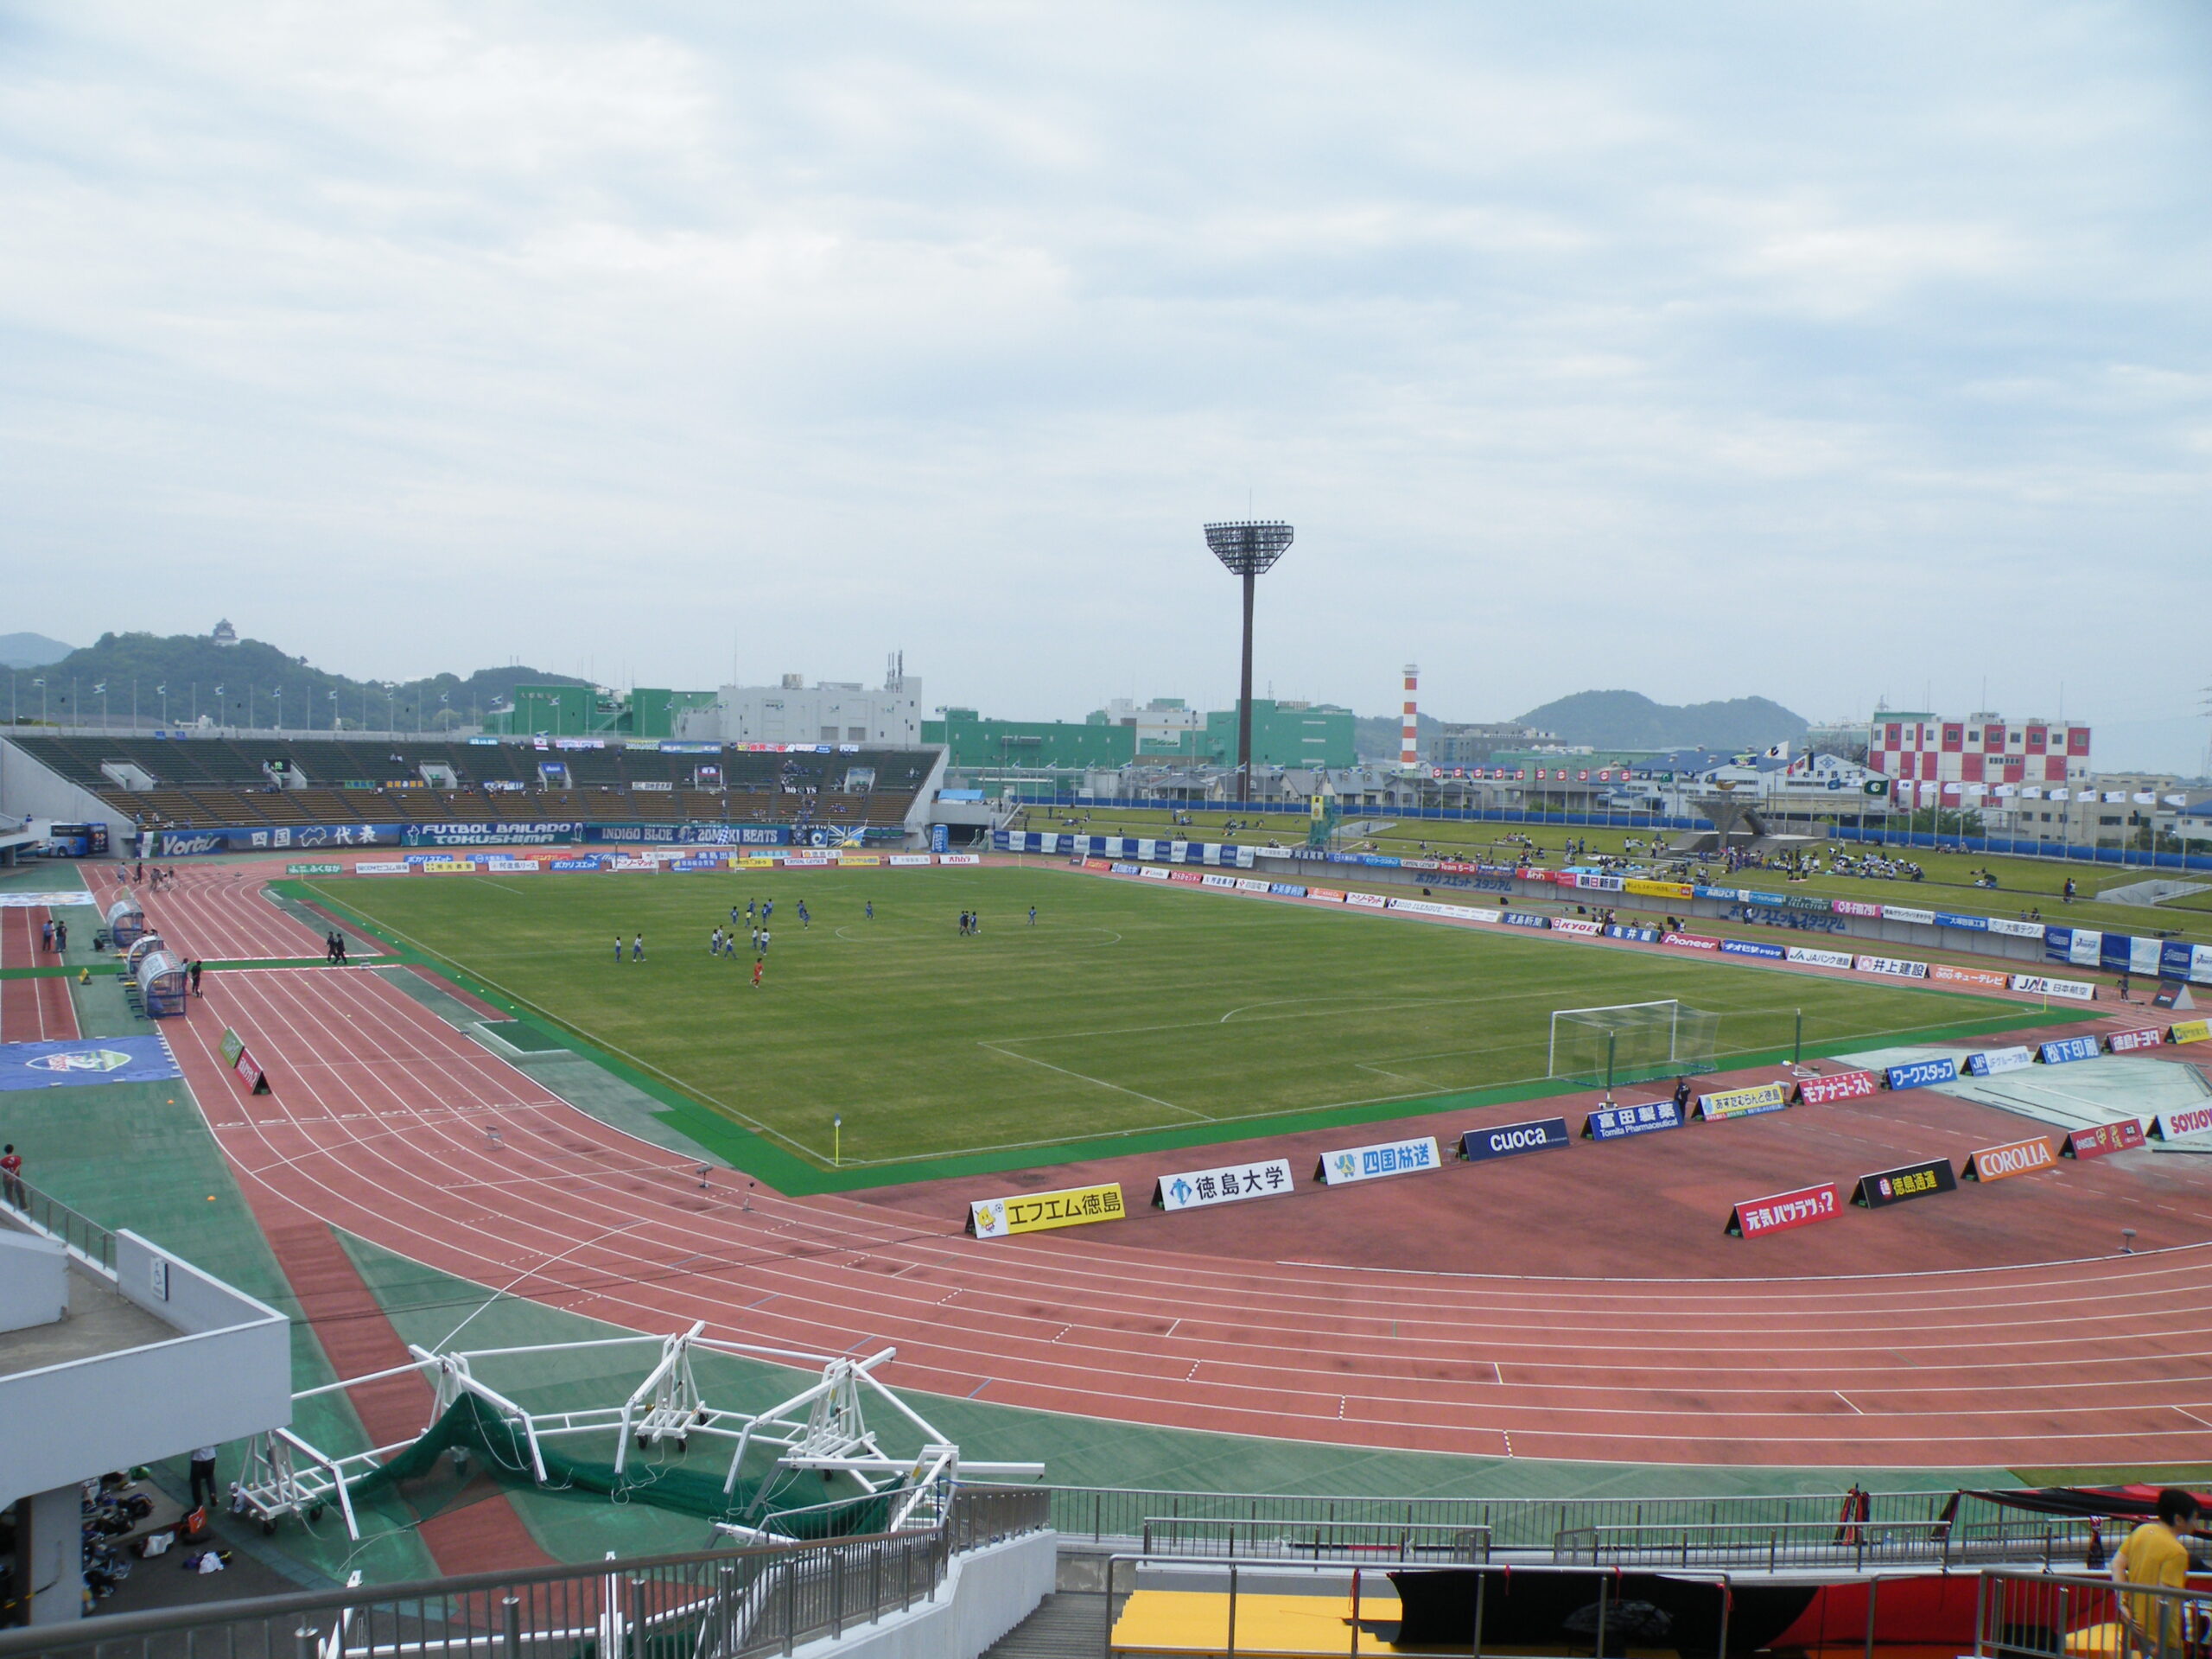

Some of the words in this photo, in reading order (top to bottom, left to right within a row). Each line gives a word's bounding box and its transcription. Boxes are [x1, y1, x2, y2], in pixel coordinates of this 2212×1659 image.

[251, 828, 290, 847] 四国
[334, 824, 378, 844] 代表
[422, 823, 491, 835] FUTBOL
[496, 823, 571, 834] BAILADO
[433, 834, 555, 844] TOKUSHIMA
[601, 827, 640, 842] INDIGO
[643, 827, 673, 842] BLUE
[697, 828, 740, 842] ZOMKI
[742, 828, 779, 842] BEATS
[162, 832, 220, 856] Vortis
[554, 860, 598, 869] ポカリスエット
[1580, 875, 1619, 889] 朝日新聞
[1508, 912, 1544, 928] 徳島新聞
[2004, 924, 2041, 937] 大塚テクノ
[1612, 926, 1651, 942] 亀井組
[1664, 933, 1715, 950] Pioneer
[1872, 958, 1925, 977] 井上建設
[1954, 970, 2004, 986] キューテレビ
[2018, 976, 2049, 994] JAL
[2053, 983, 2088, 996] 日本航空
[2045, 1037, 2100, 1064] 松下印刷
[2113, 1029, 2160, 1052] 徳島トヨタ
[1891, 1061, 1955, 1087] ワークスタッフ
[1715, 1090, 1781, 1110] あすたむらんど徳島
[1803, 1077, 1874, 1104] モアナコースト
[1597, 1103, 1676, 1129] 富田製薬
[1599, 1124, 1625, 1139] Tomita
[1625, 1117, 1679, 1134] Pharmaceutical
[1489, 1127, 1547, 1152] cuoca
[1362, 1142, 1431, 1175] 四国放送
[1979, 1143, 2052, 1177] COROLLA
[1195, 1165, 1286, 1200] 徳島大学
[1892, 1170, 1938, 1197] 徳島通運
[1008, 1189, 1122, 1226] エフエム徳島
